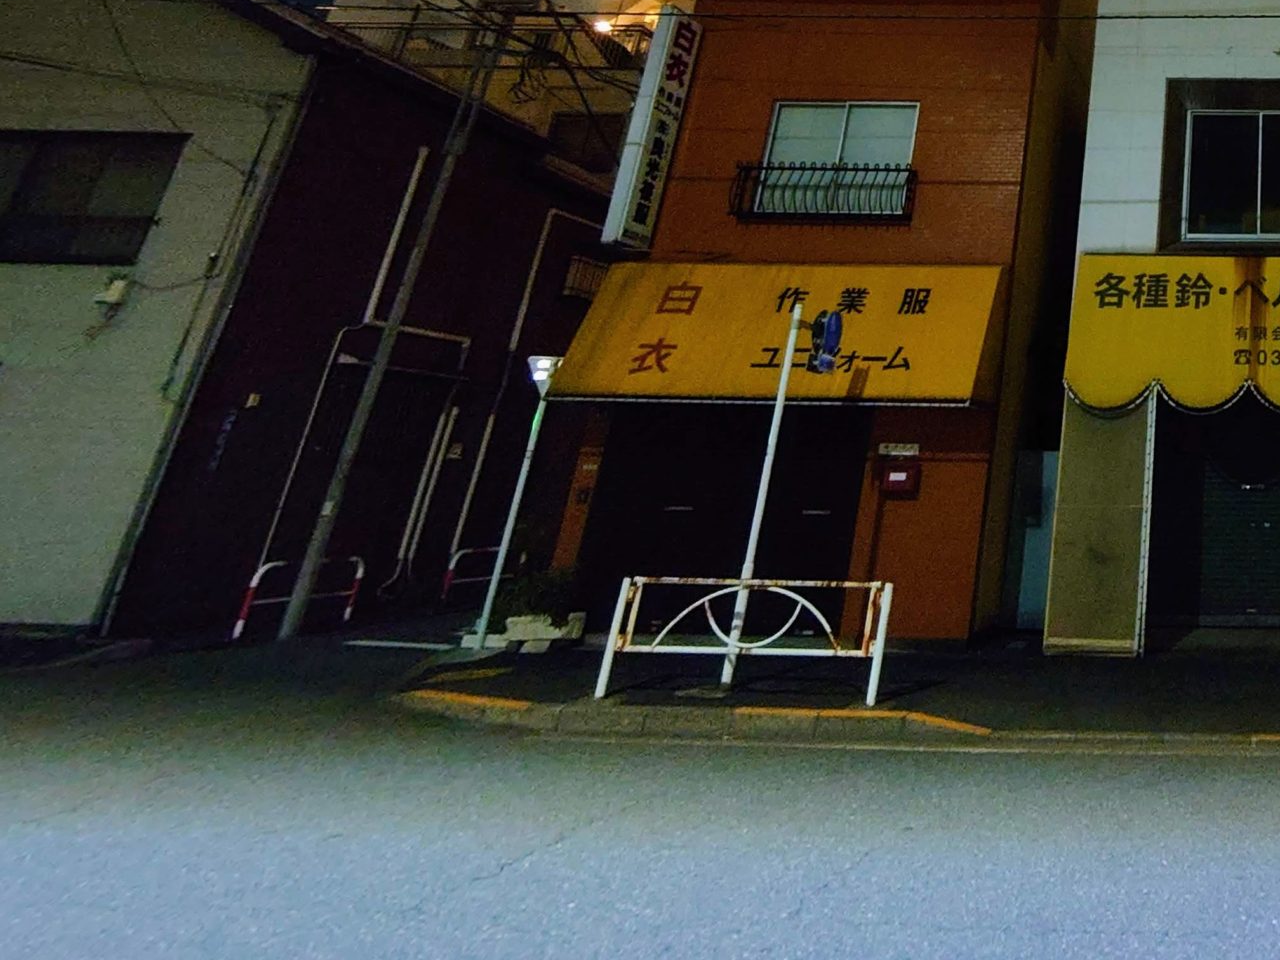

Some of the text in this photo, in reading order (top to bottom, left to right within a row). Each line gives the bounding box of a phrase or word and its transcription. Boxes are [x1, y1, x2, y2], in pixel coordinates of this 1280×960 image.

[750, 345, 912, 375] ユニォーム
